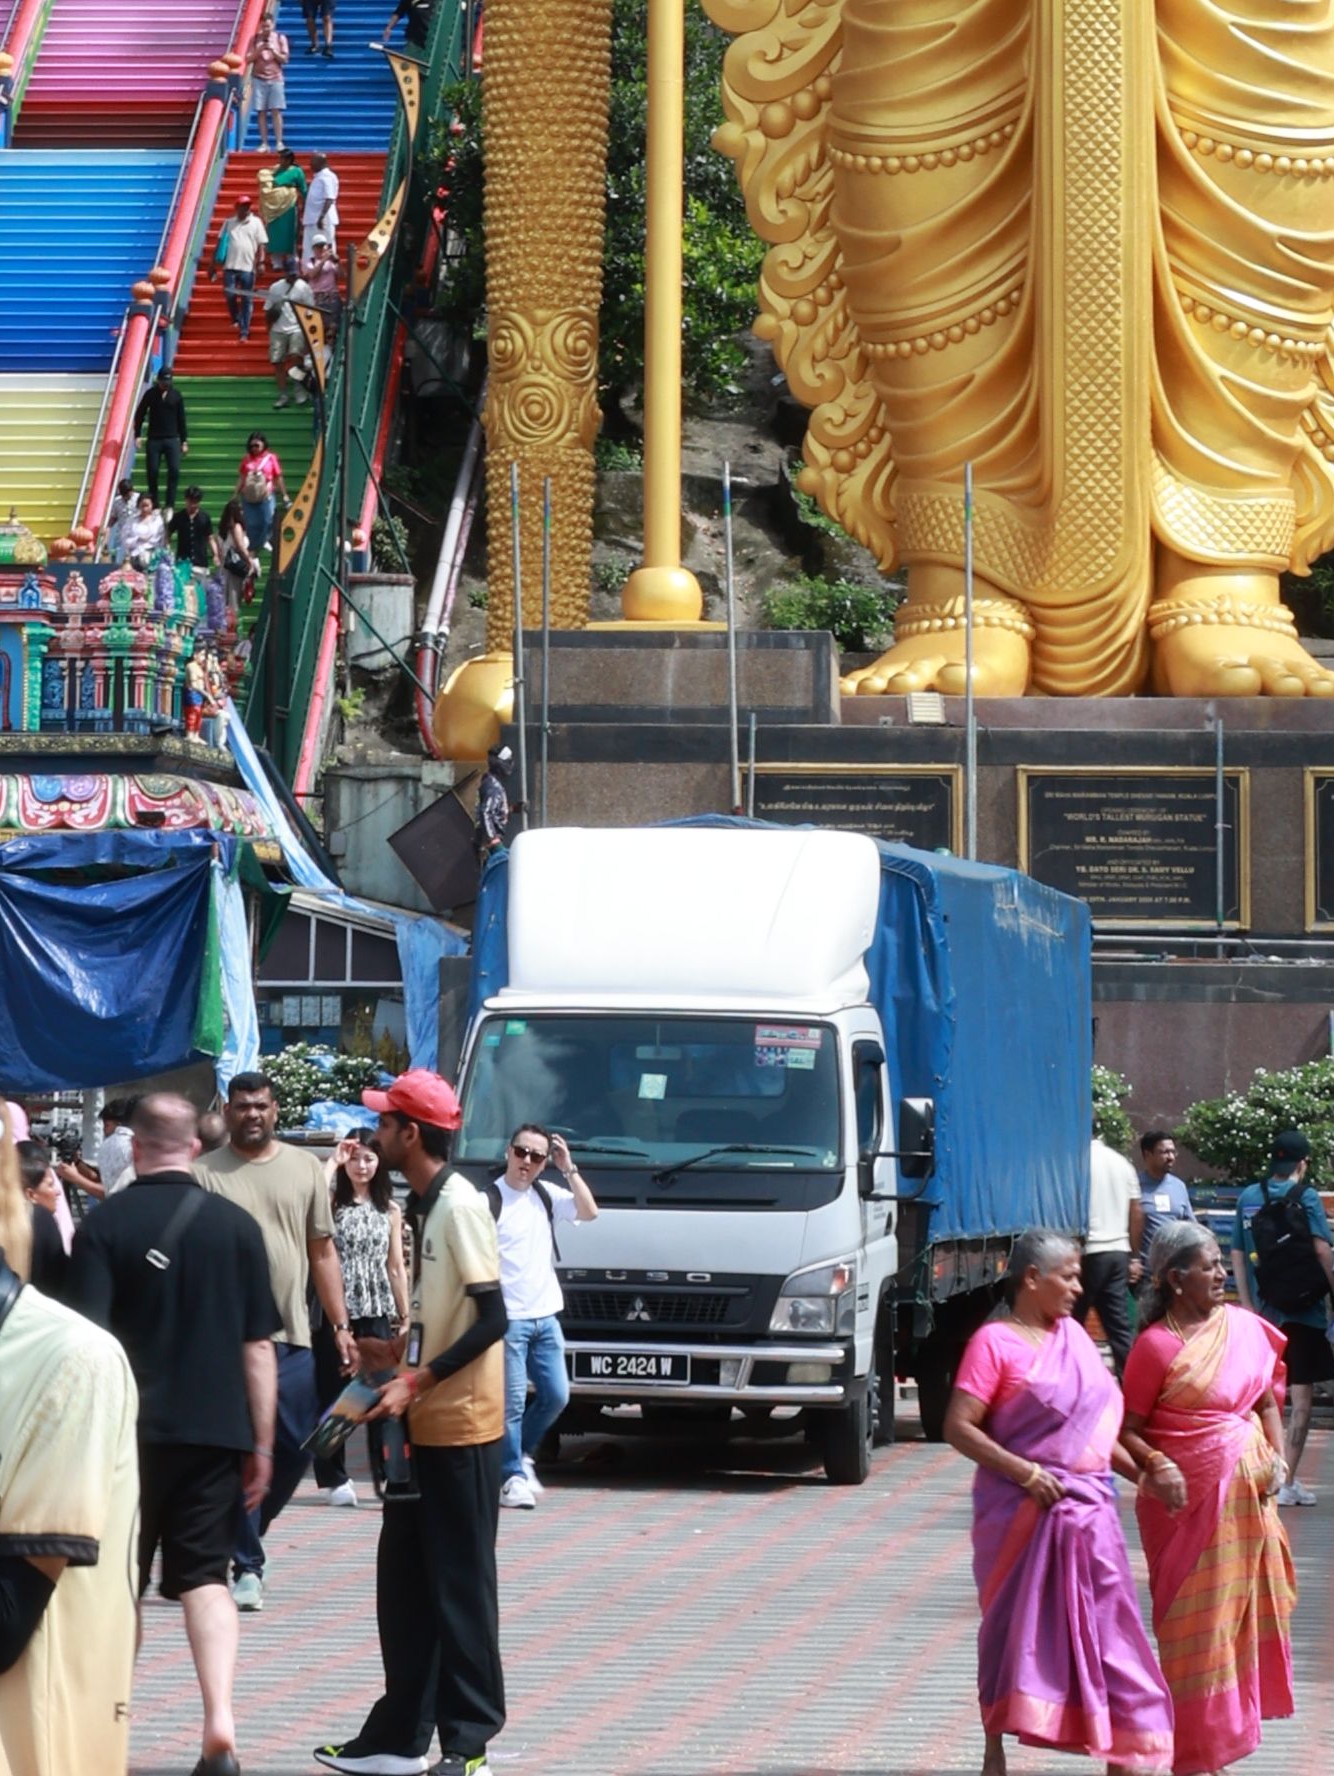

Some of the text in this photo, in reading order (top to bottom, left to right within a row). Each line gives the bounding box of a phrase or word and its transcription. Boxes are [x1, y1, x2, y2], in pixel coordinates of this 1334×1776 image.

[567, 1270, 711, 1282] FUSO
[590, 1356, 672, 1376] WC 2424 W
